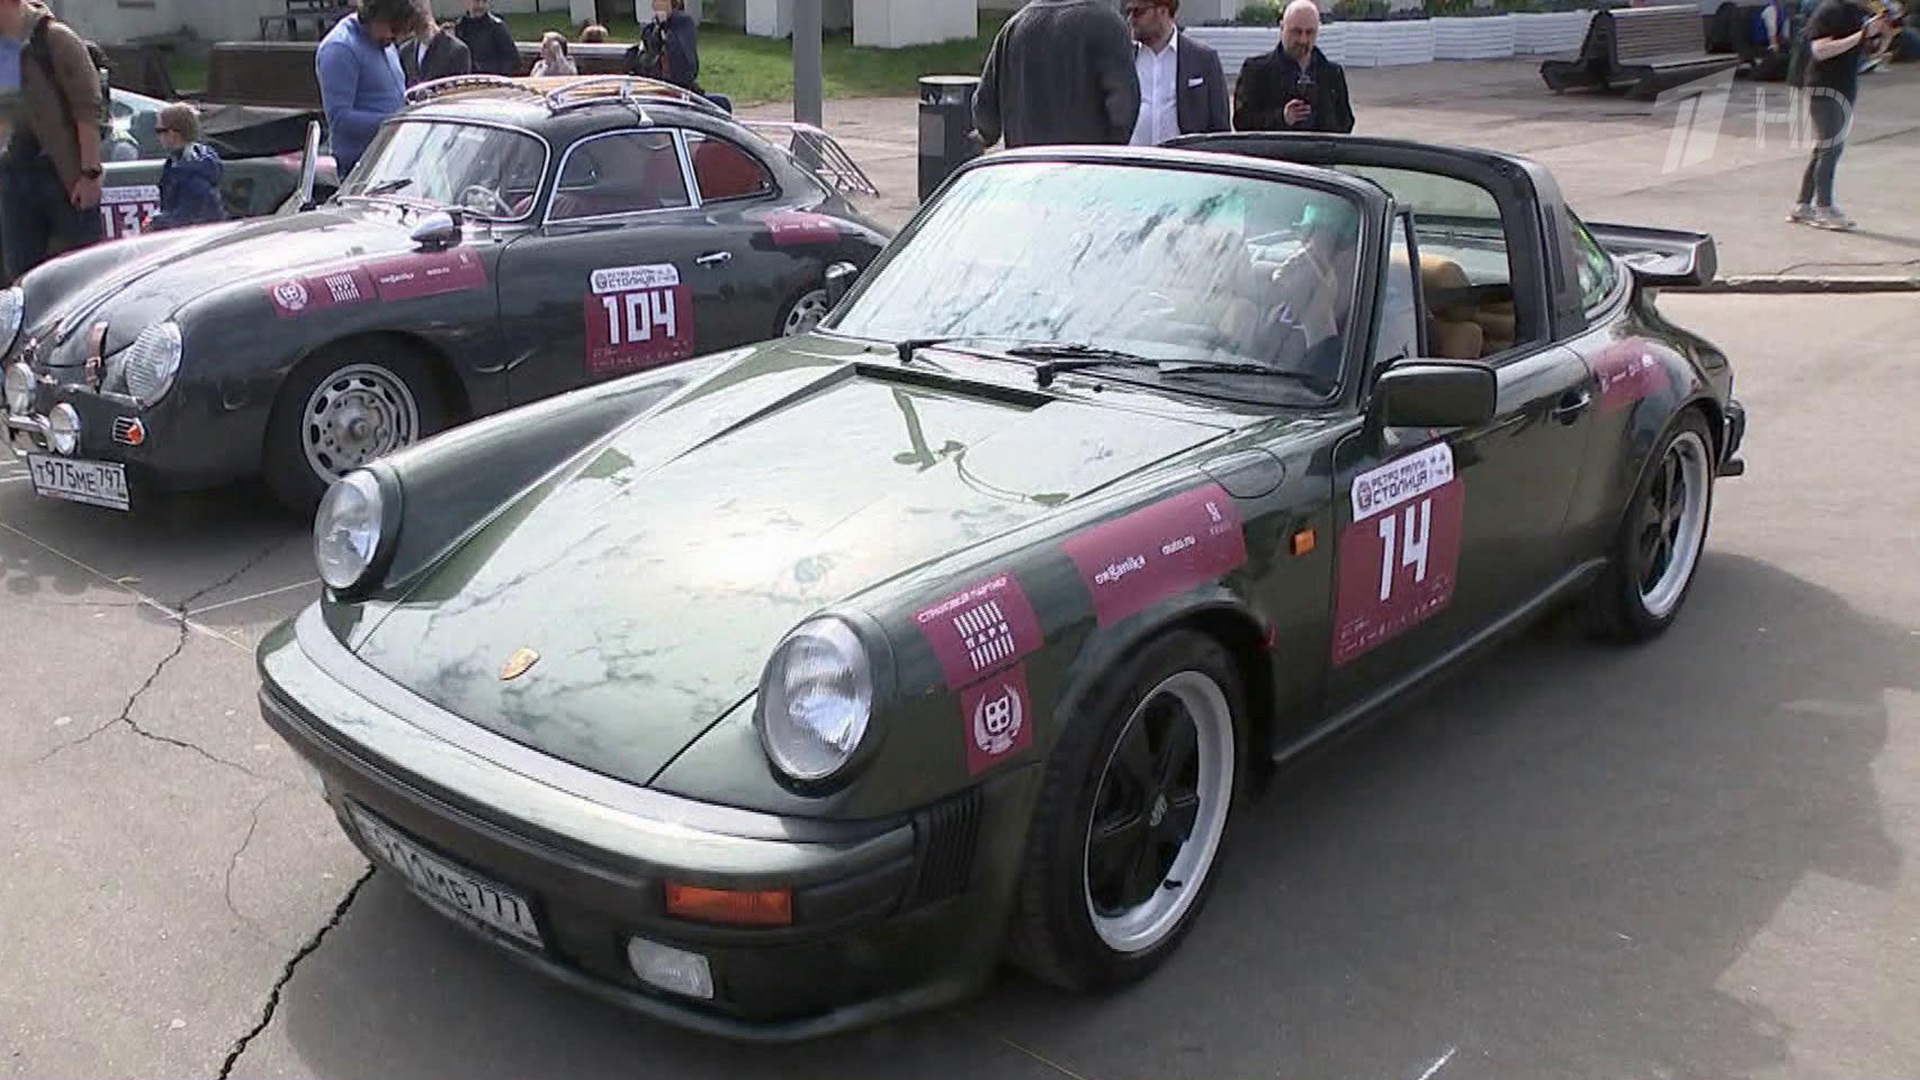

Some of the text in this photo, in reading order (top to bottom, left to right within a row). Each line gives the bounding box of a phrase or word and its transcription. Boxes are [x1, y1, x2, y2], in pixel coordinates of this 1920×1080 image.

[602, 289, 676, 345] 104
[1373, 469, 1428, 504] СТОЛИЦА
[1379, 497, 1431, 602] 14
